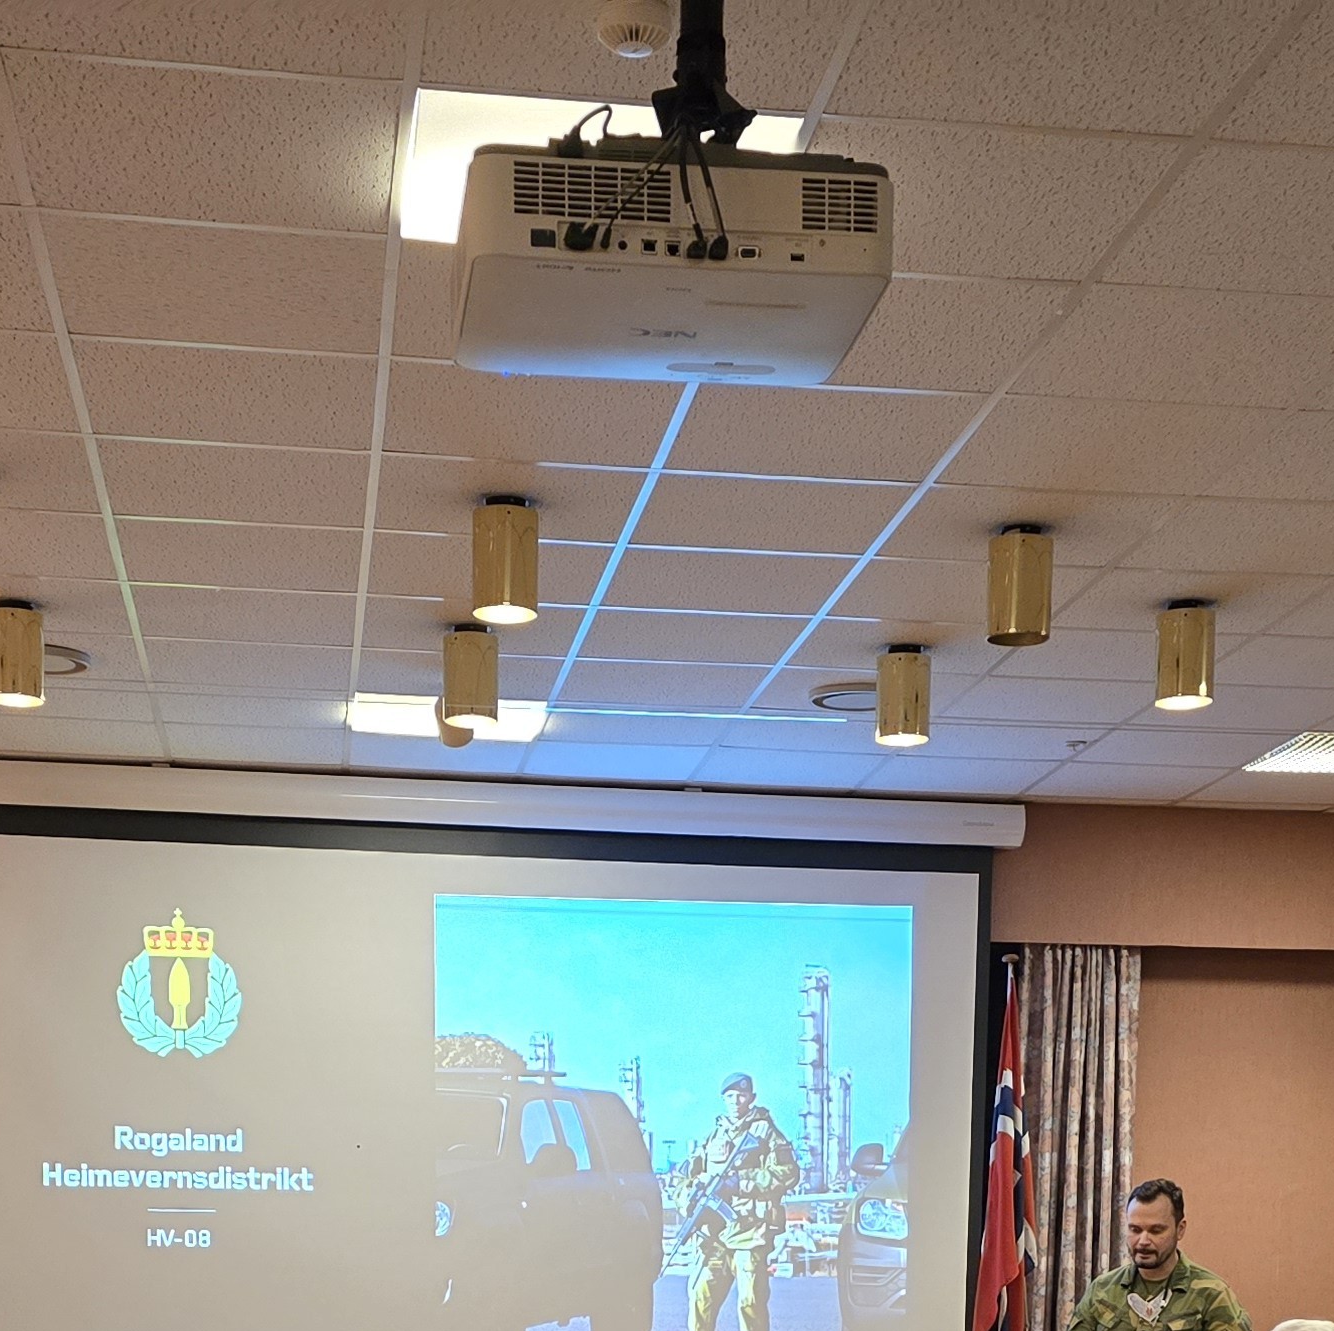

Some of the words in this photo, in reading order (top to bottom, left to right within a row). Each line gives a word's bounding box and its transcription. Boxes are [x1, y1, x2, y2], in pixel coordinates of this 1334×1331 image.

[630, 327, 698, 339] NEC
[113, 1125, 244, 1157] Rogaland
[42, 1161, 315, 1192] Heimevernsdistrikt
[146, 1228, 212, 1248] HV-08
